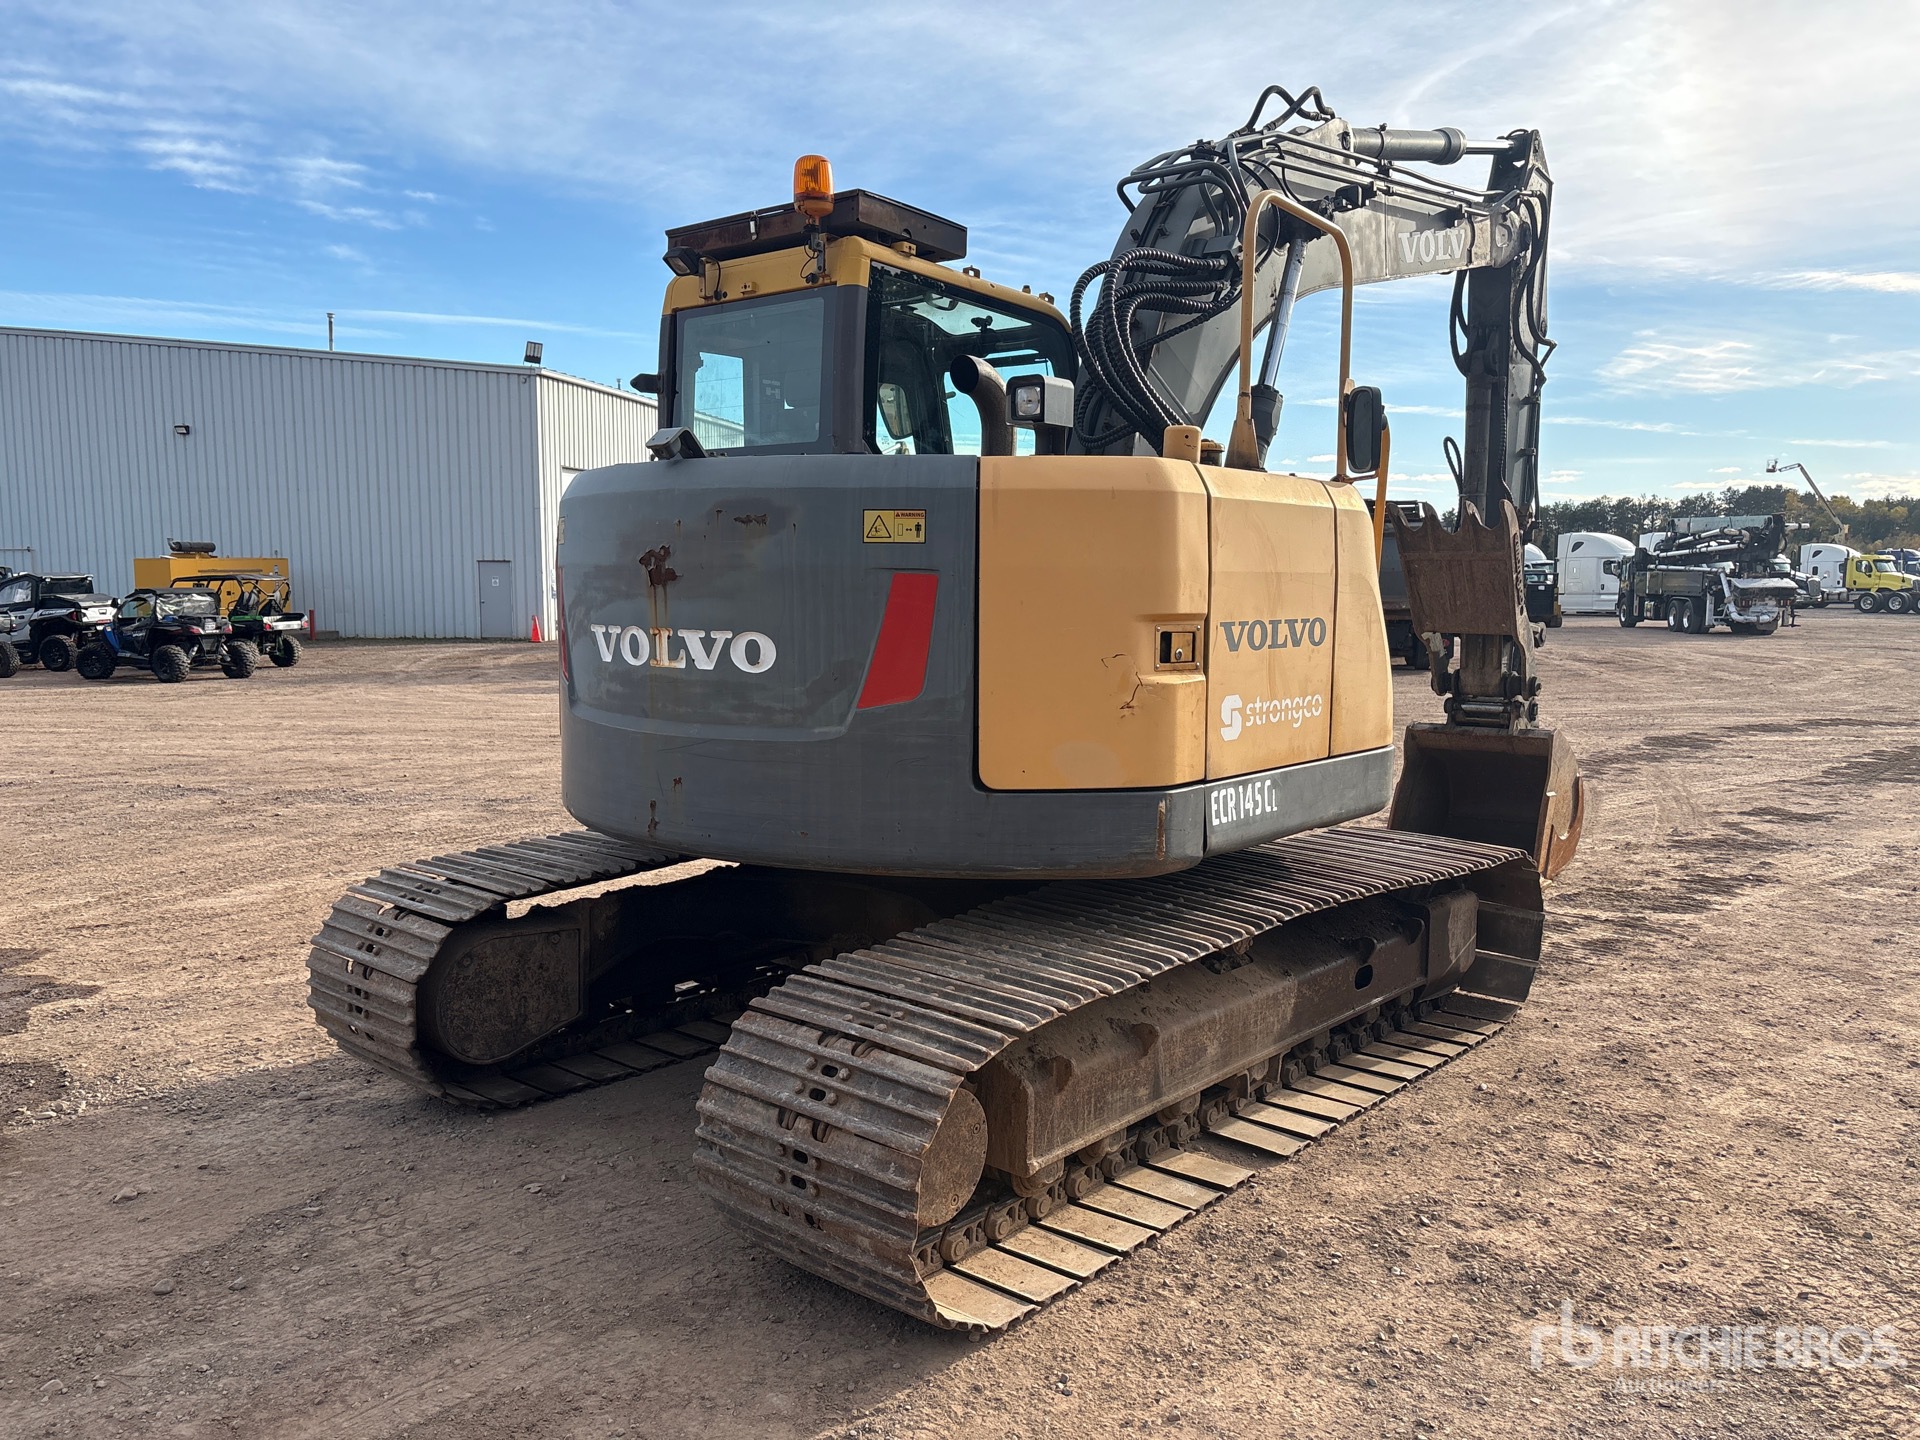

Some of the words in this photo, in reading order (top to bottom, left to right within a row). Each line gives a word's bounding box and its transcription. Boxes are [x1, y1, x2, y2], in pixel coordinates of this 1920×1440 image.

[591, 624, 777, 674] VOLVO
[1220, 617, 1327, 652] VOLVO
[1245, 694, 1323, 729] strongco
